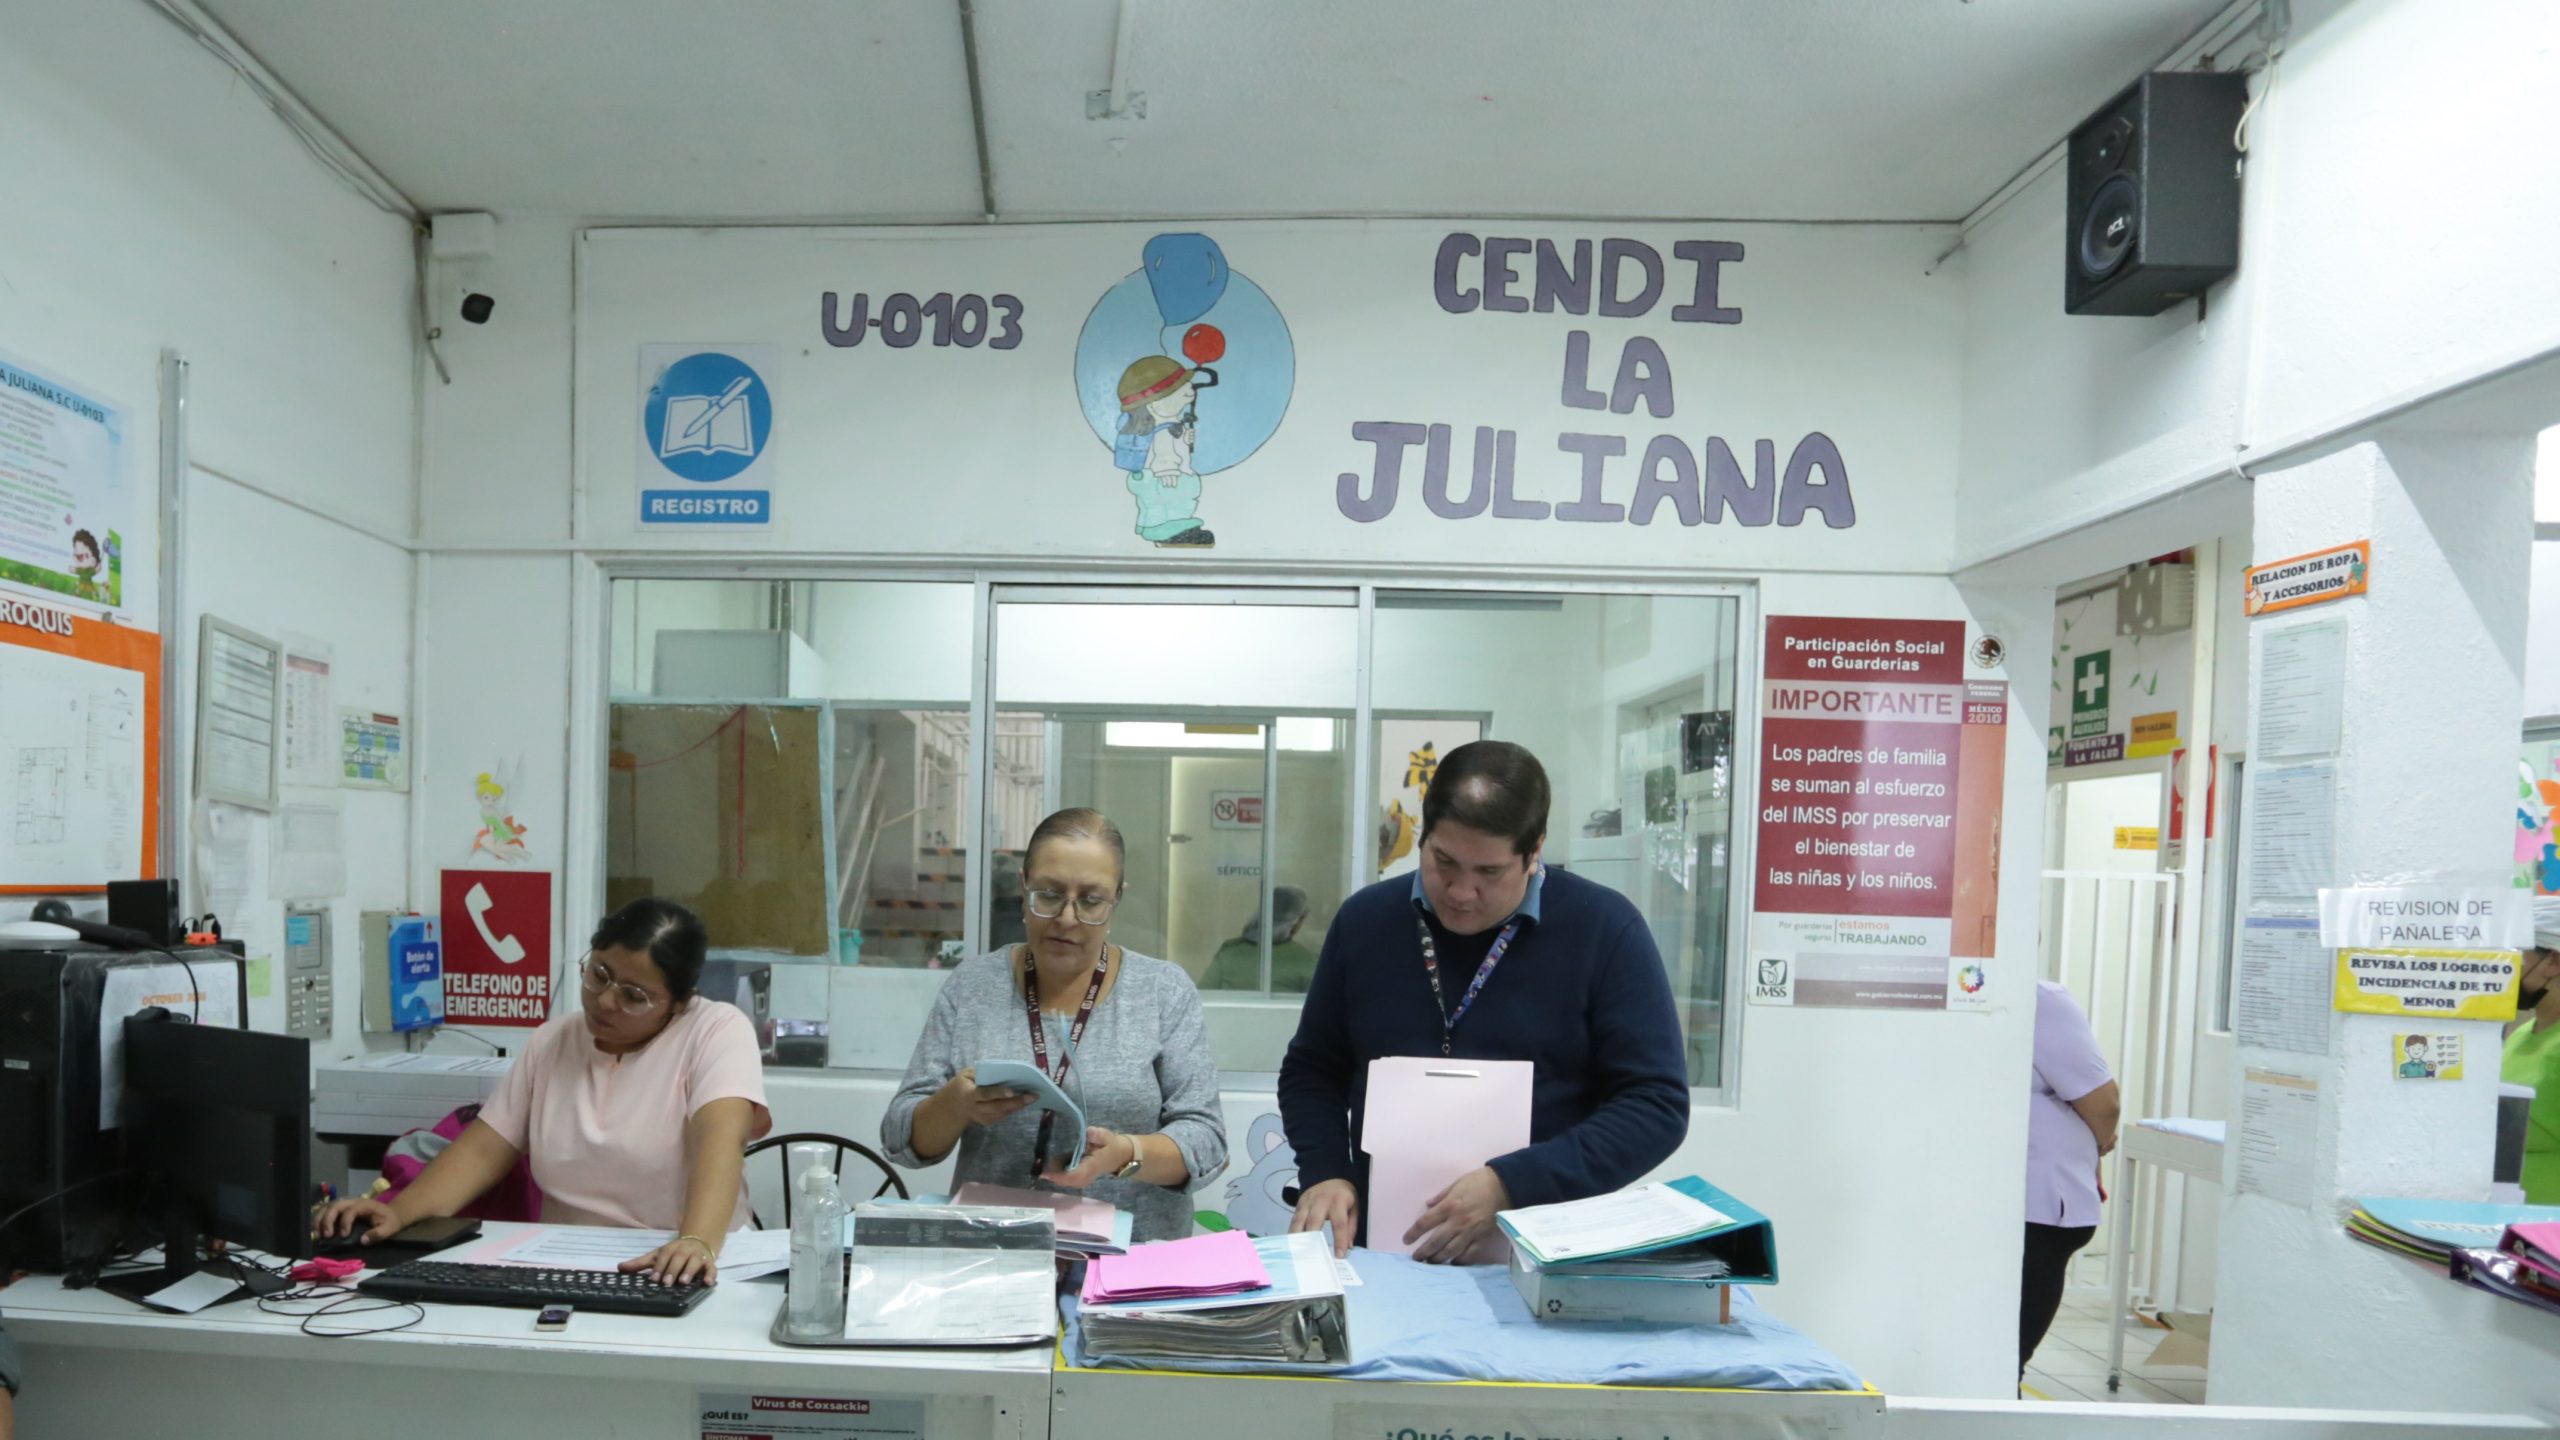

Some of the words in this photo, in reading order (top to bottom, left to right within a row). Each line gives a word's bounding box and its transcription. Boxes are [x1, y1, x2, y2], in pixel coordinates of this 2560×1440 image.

[1434, 233, 1745, 324] CENDI
[821, 291, 1024, 350] U-0103
[1560, 330, 1674, 418] LA
[8, 372, 54, 401] JULIANA
[73, 401, 104, 423] U-0103
[1336, 420, 1856, 529] JULIANA
[651, 498, 759, 516] REGISTRO
[2252, 565, 2307, 585] RELACION
[2309, 561, 2324, 573] DE
[2327, 552, 2359, 569] ROPA
[2264, 592, 2270, 602] Y
[2273, 576, 2344, 600] ACCESORIOS
[1785, 637, 1890, 654] Participación
[1895, 640, 1945, 655] Social
[1807, 657, 1827, 669] en
[1832, 656, 1920, 671] Guarderías
[1771, 689, 1953, 715] IMPORTANTE
[1968, 704, 2002, 713] MÉXICO
[1968, 713, 2002, 724] 2010
[1773, 744, 1802, 761] Los
[1807, 746, 1863, 765] padres
[1868, 747, 1888, 764] de
[1894, 747, 1946, 766] familia
[2075, 752, 2086, 763] LA
[2090, 748, 2119, 760] SALUD
[1771, 779, 1790, 792] se
[1795, 779, 1850, 794] suman
[1855, 778, 1869, 794] al
[1875, 779, 1945, 797] esfuerzo
[1763, 806, 1787, 823] del
[1793, 807, 1837, 824] IMSS
[1842, 811, 1869, 828] por
[1873, 813, 1951, 828] preservar
[1795, 839, 1810, 855] el
[1815, 839, 1891, 857] bienestar
[1894, 841, 1916, 858] de
[1769, 868, 1793, 885] las
[1798, 869, 1841, 887] niñas
[1846, 875, 1856, 891] y
[1861, 871, 1884, 888] los
[1889, 872, 1938, 890] niños.
[2369, 901, 2460, 916] REVISION
[2467, 901, 2493, 916] DE
[1839, 920, 1890, 930] estamos
[2380, 923, 2482, 941] PAÑALERA
[1839, 933, 1927, 946] TRABAJANDO
[2351, 958, 2406, 971] REVISA
[2410, 961, 2437, 972] LOS
[2441, 962, 2499, 974] LOGROS
[2502, 964, 2513, 975] O
[444, 974, 522, 995] TELEFONO
[527, 975, 547, 996] DE
[1756, 986, 1787, 998] IMSS
[2358, 977, 2456, 990] INCIDENCIAS
[2459, 981, 2480, 991] DE
[2483, 983, 2503, 992] TU
[446, 996, 545, 1019] EMERGENCIA
[2403, 997, 2456, 1008] MENOR
[753, 1399, 785, 1409] Virus
[787, 1400, 803, 1410] de
[806, 1401, 868, 1412] Coxsackie
[702, 1410, 729, 1421] ¿QUÉ
[731, 1412, 749, 1421] ES?
